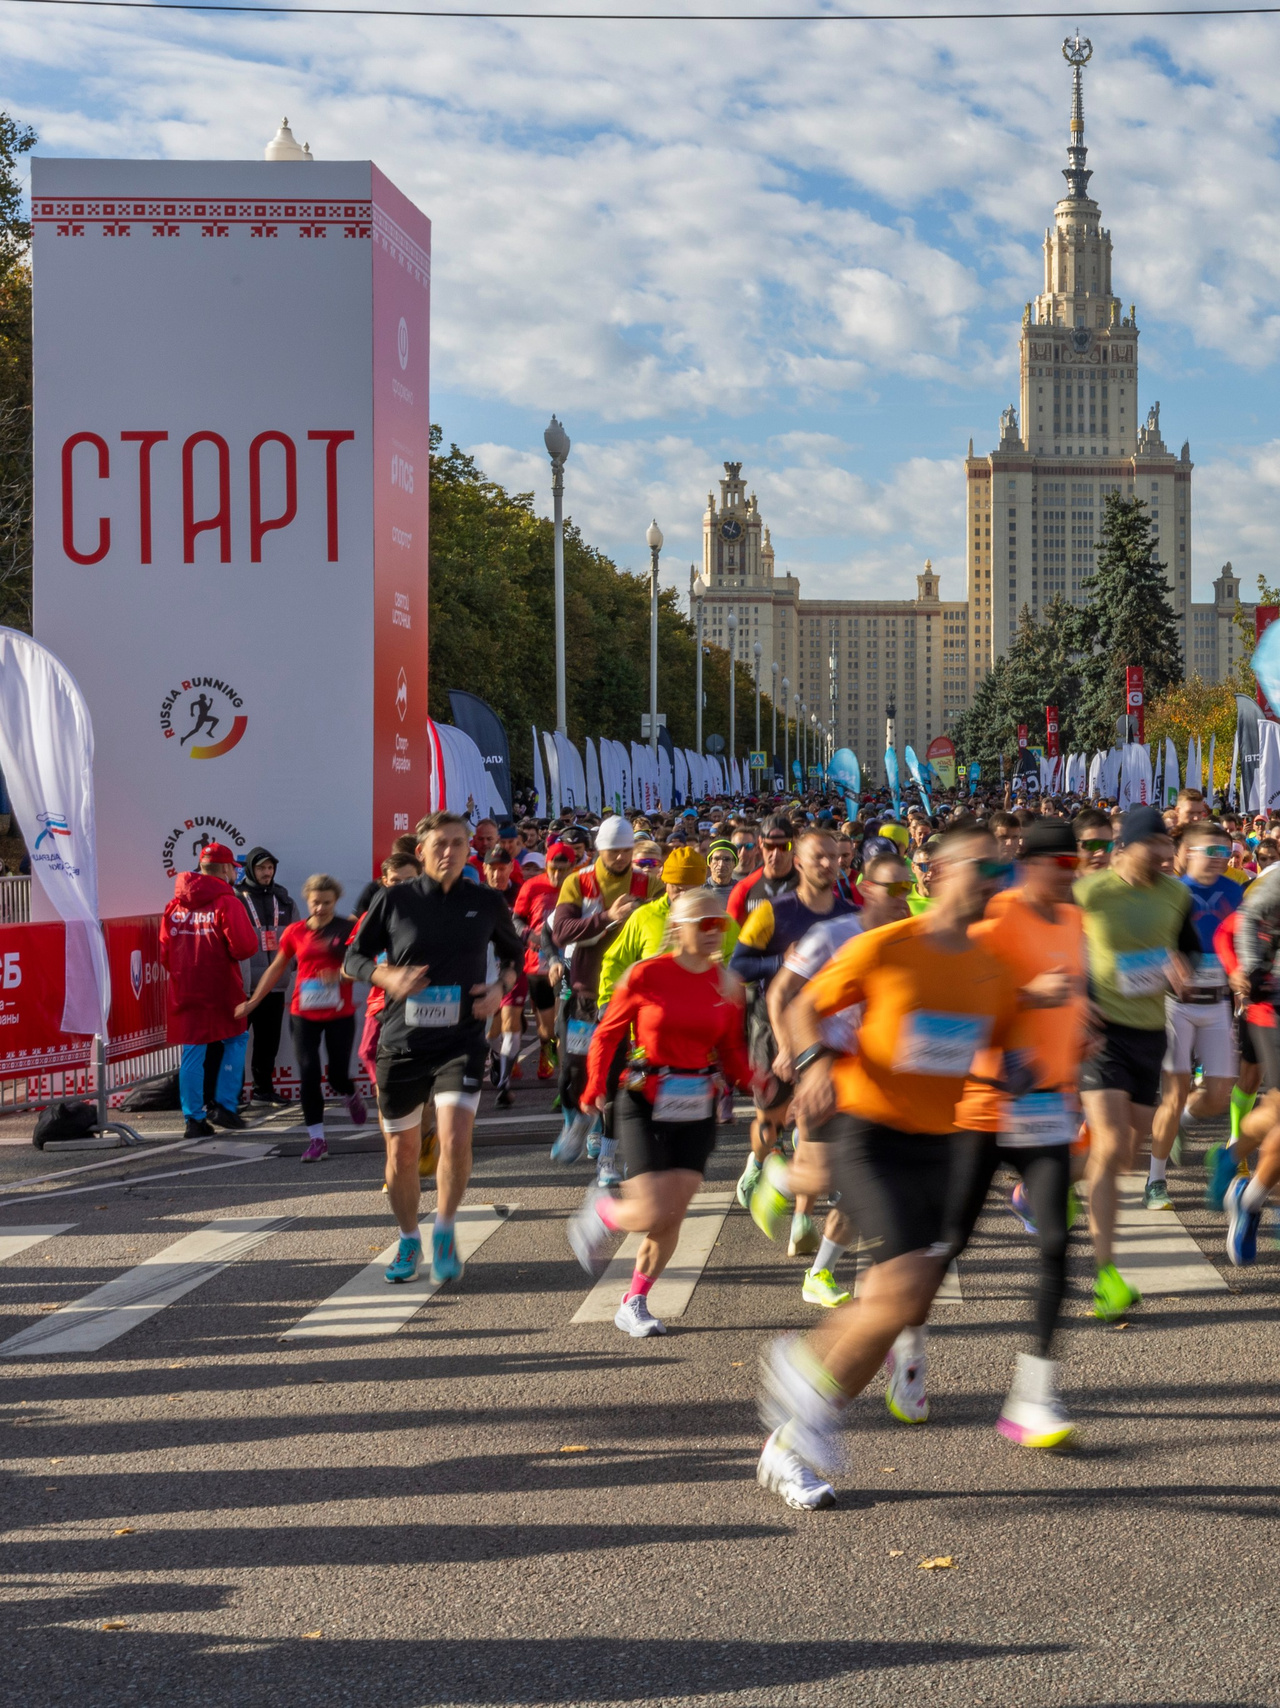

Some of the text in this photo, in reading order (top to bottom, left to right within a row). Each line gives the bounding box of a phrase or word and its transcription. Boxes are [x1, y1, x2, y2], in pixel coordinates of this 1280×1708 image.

[61, 430, 355, 565] СТАРТ
[160, 677, 244, 740] RUSSIA RUNNING
[163, 816, 246, 878] RUSSIA RUNNING
[171, 911, 215, 925] СУДЬЯ
